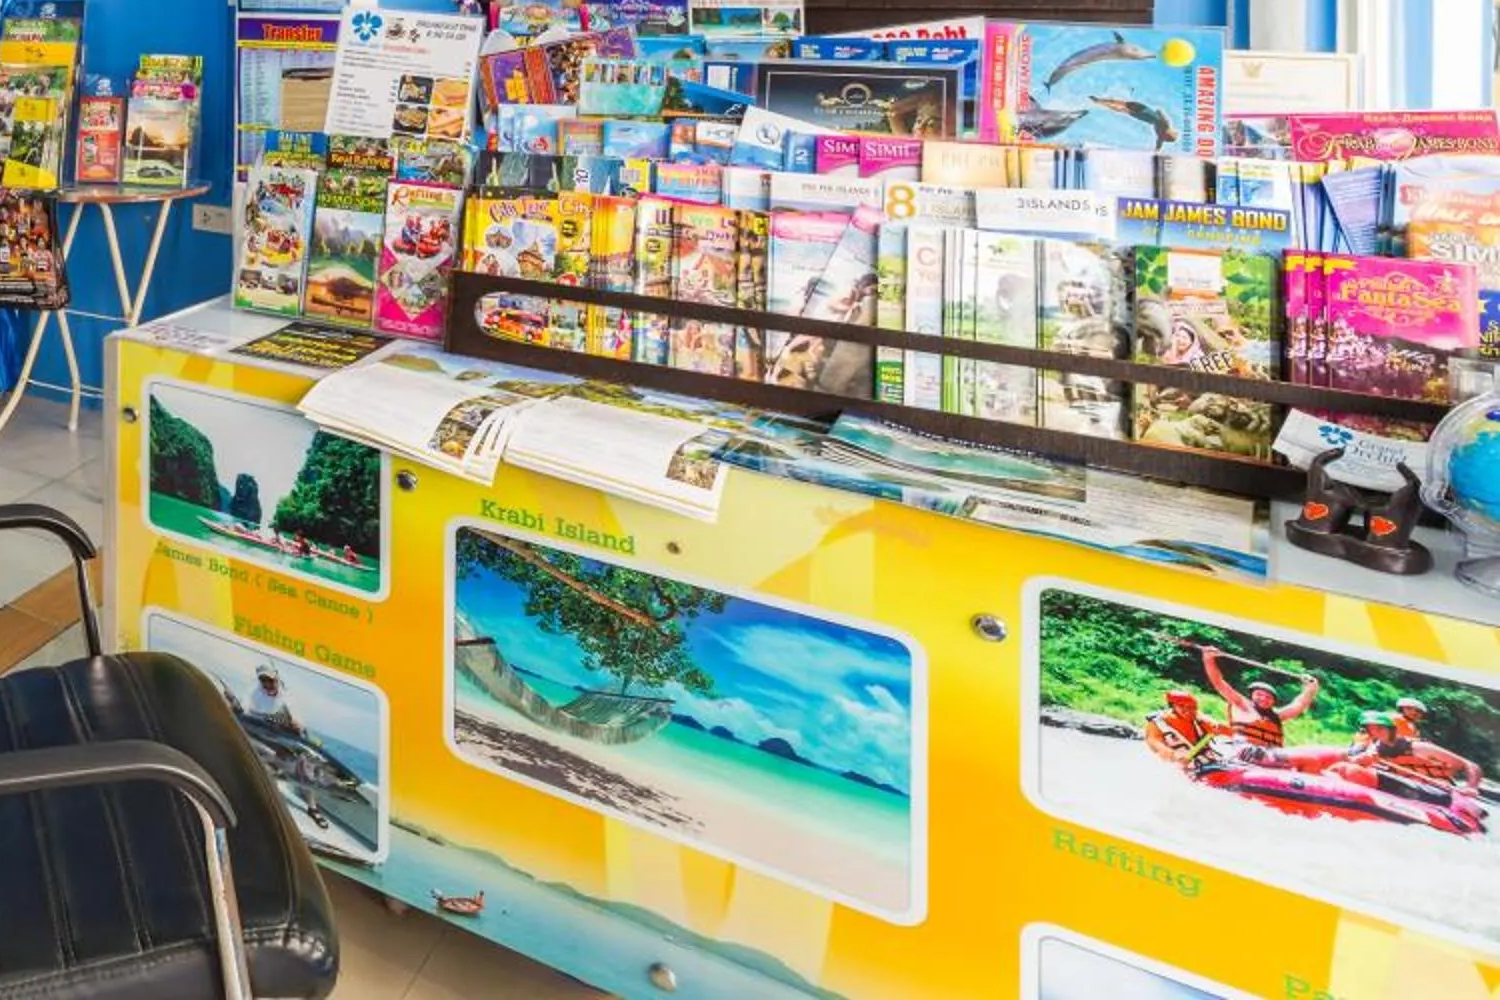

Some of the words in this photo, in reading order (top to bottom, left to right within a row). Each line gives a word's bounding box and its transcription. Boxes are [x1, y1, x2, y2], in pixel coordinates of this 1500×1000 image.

[1196, 67, 1217, 133] AMAZING
[886, 184, 916, 219] 8
[1164, 203, 1226, 227] JAMES
[1232, 210, 1287, 232] BOND
[1190, 351, 1235, 372] FREE
[480, 499, 546, 532] Krabi
[556, 517, 637, 555] Island
[156, 541, 203, 568] James
[208, 555, 249, 585] Bond
[268, 579, 297, 599] Sea
[306, 589, 360, 619] Canoe
[235, 615, 305, 658] Fishing
[315, 644, 377, 679] Game
[1053, 828, 1204, 897] Rafting
